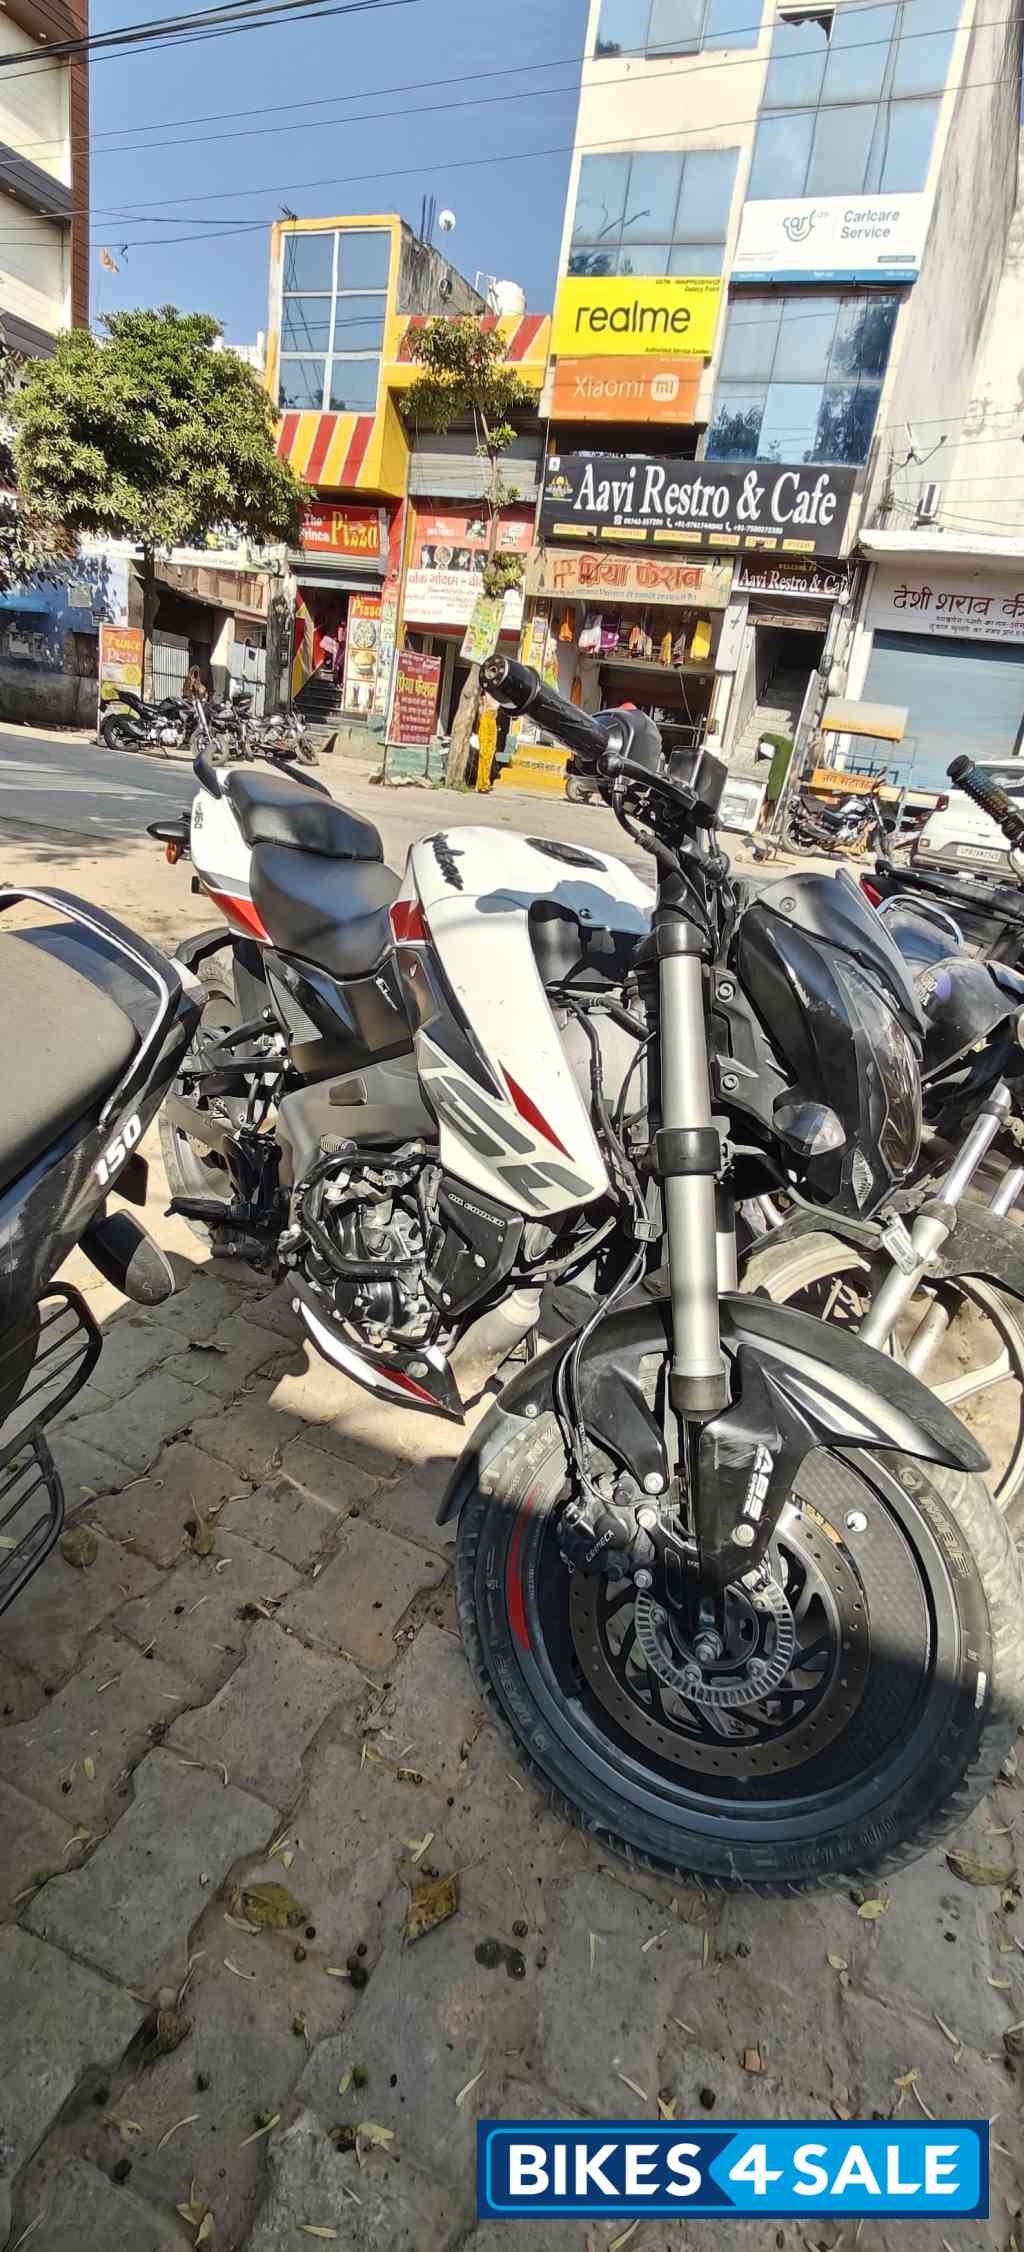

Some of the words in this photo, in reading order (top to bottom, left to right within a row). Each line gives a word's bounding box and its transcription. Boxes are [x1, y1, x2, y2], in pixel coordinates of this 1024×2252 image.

[843, 209, 900, 224] Carlcare
[840, 226, 891, 239] Service
[575, 300, 691, 333] realme
[573, 374, 646, 398] Xiaomi
[573, 464, 636, 512] Aavi
[638, 465, 730, 518] Restro
[736, 470, 765, 520] &
[770, 472, 837, 526] Cafe
[302, 512, 323, 526] The
[331, 511, 378, 549] Pizza
[738, 568, 768, 588] Aavi
[767, 570, 807, 591] Restro
[808, 574, 821, 592] &
[823, 575, 852, 594] Caf
[351, 596, 382, 618] Pizza
[893, 584, 933, 610] देशी
[95, 1114, 142, 1186] 150
[748, 1443, 774, 1521] ABS
